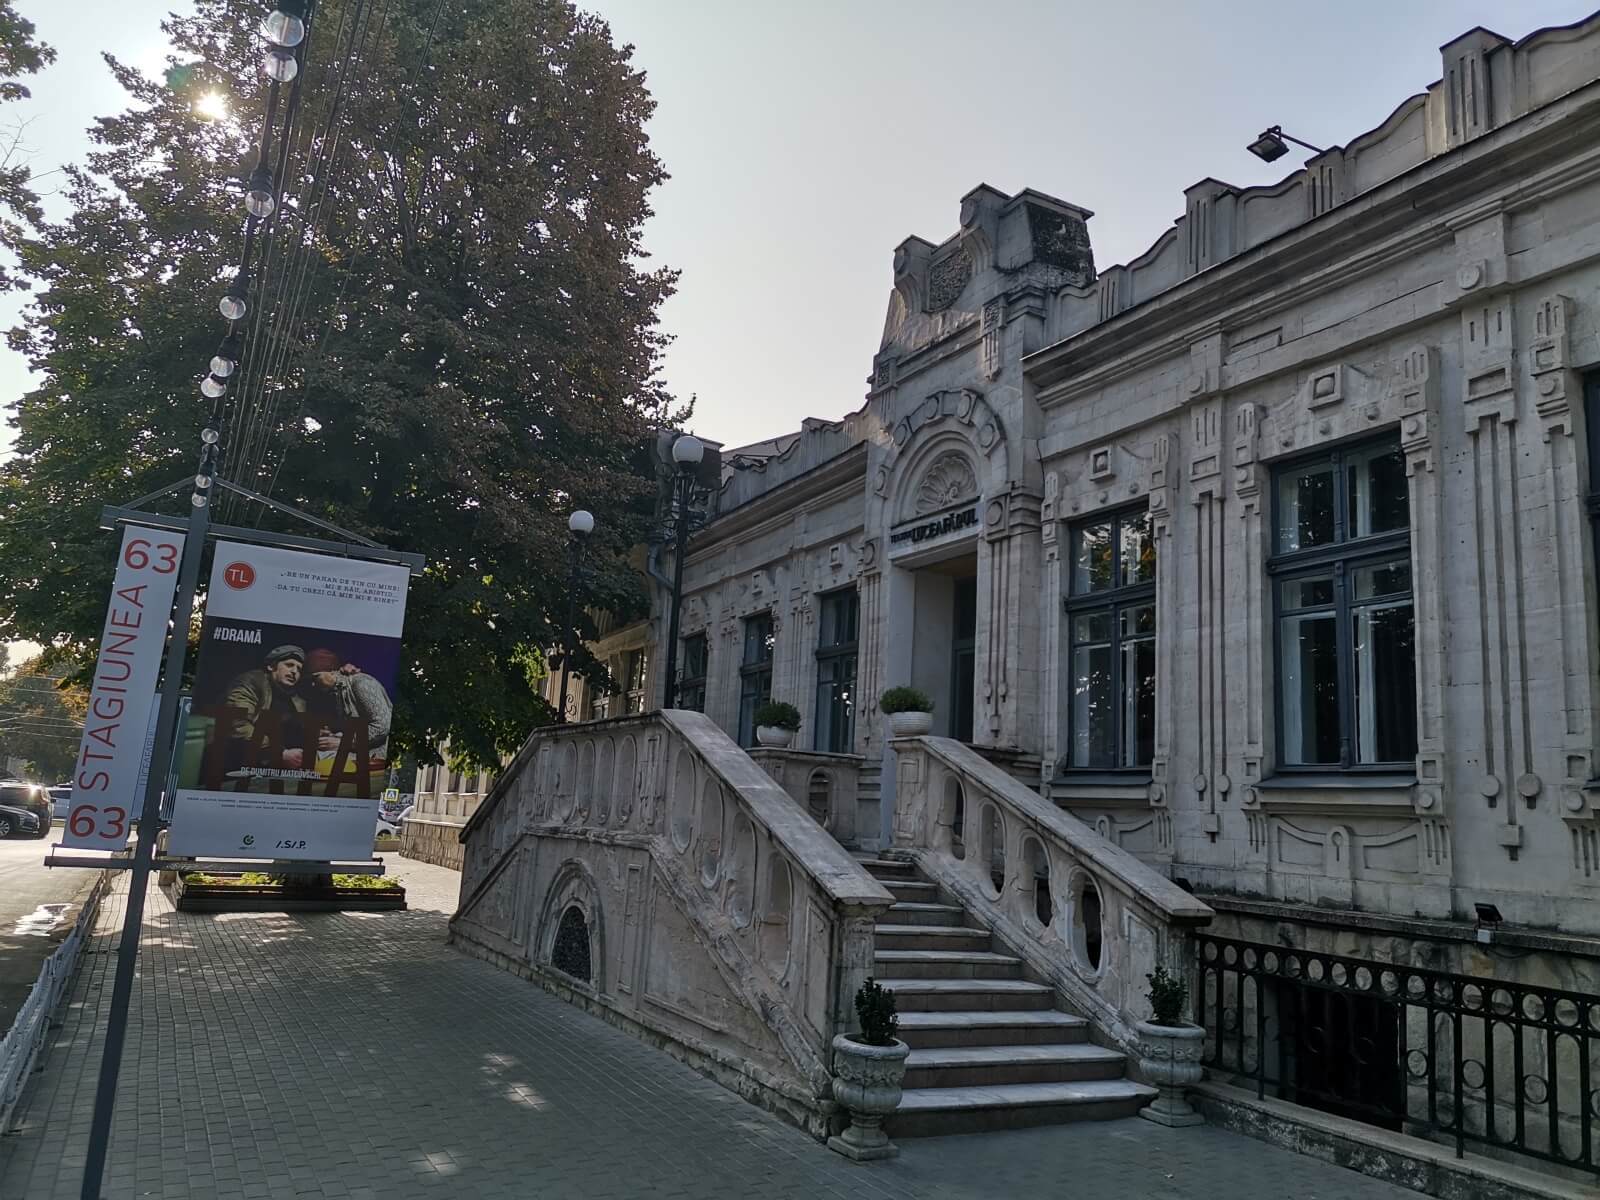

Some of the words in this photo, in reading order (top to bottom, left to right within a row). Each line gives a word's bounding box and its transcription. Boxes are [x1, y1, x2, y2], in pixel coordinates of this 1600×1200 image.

[124, 539, 179, 574] 63
[229, 568, 249, 584] TL
[213, 626, 262, 645] #DRAMĂ
[78, 584, 148, 792] STAGIUNEA
[69, 804, 126, 840] 63
